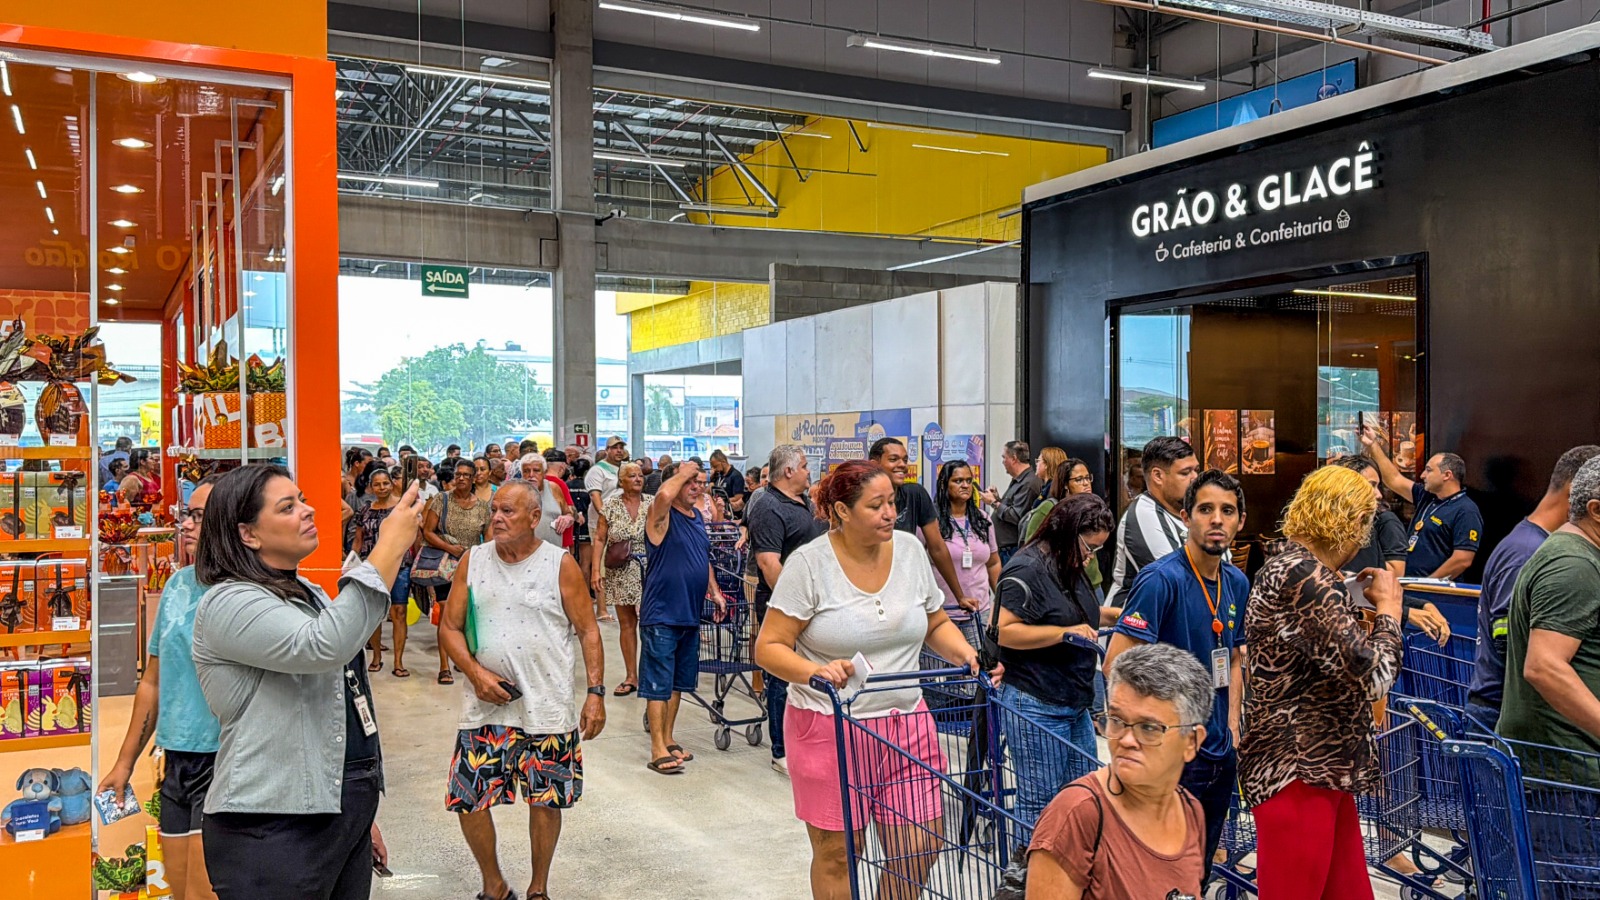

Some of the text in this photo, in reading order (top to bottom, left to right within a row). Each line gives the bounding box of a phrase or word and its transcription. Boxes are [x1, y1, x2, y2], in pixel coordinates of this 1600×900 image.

[1131, 140, 1374, 237] GRÃO & GLACÊ
[1172, 216, 1332, 260] Cafeteria & Confeitaria
[426, 269, 465, 284] SAÍDA
[801, 418, 835, 436] Roldão
[924, 431, 944, 440] Roldão
[931, 440, 943, 449] pay
[1469, 529, 1478, 541] R
